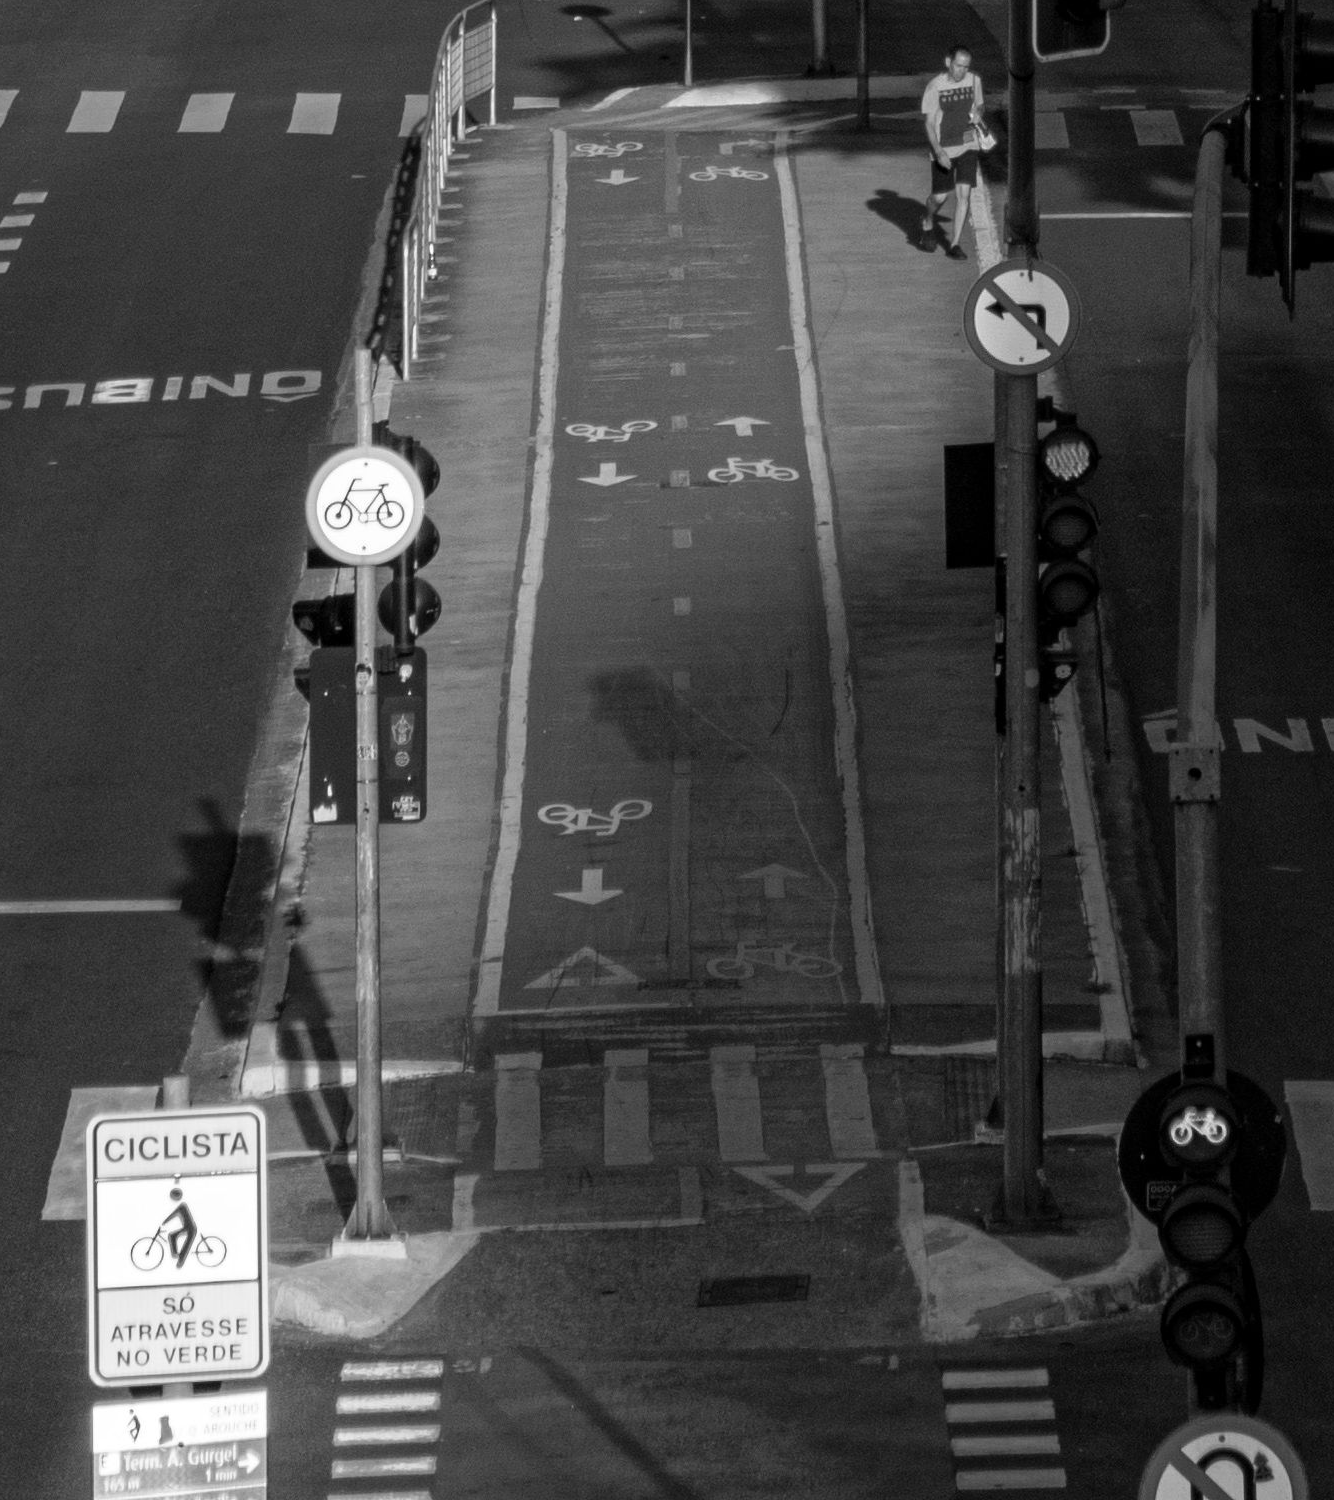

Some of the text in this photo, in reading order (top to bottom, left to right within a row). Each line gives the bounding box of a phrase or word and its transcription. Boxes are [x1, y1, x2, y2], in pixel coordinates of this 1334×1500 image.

[104, 1132, 250, 1163] CICLISTA
[163, 1292, 196, 1315] SÓ
[110, 1318, 249, 1343] ATRAVESSE
[117, 1343, 243, 1368] NO VERDE
[209, 1402, 259, 1418] SENTIDO
[203, 1419, 259, 1436] AROUCHE
[123, 1442, 237, 1471] Term. A. Gurgel
[215, 1468, 237, 1482] min
